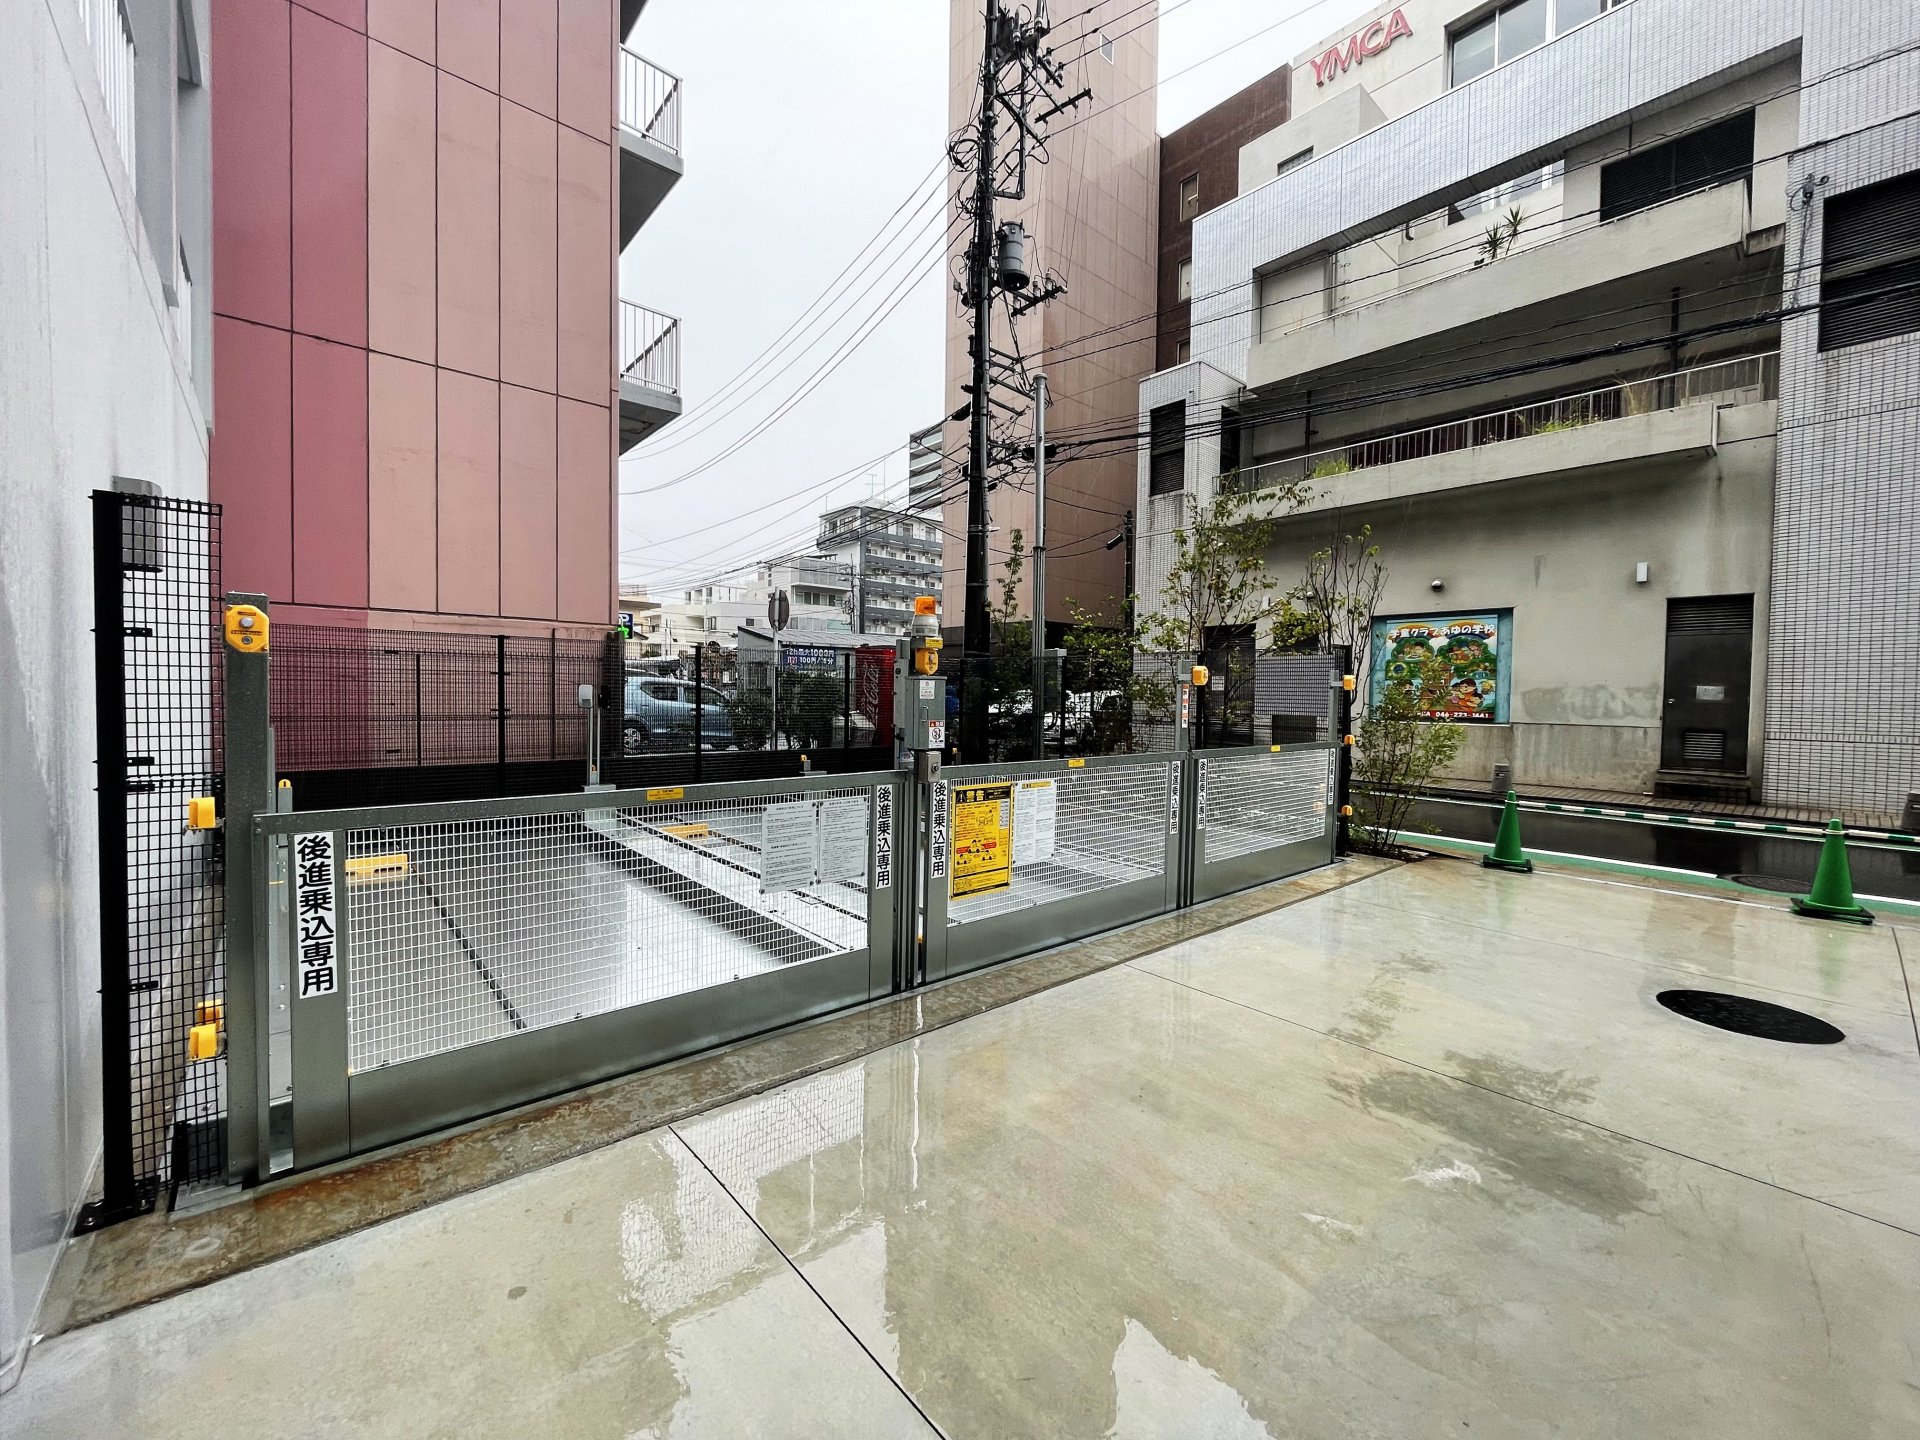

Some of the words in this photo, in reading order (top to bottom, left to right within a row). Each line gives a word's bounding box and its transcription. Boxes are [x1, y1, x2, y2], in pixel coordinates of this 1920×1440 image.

[1310, 8, 1413, 87] YMCA
[876, 786, 892, 888] 後進乗込専用
[932, 781, 947, 877] 後進乗込専用
[297, 834, 335, 996] 後進乗込専用
